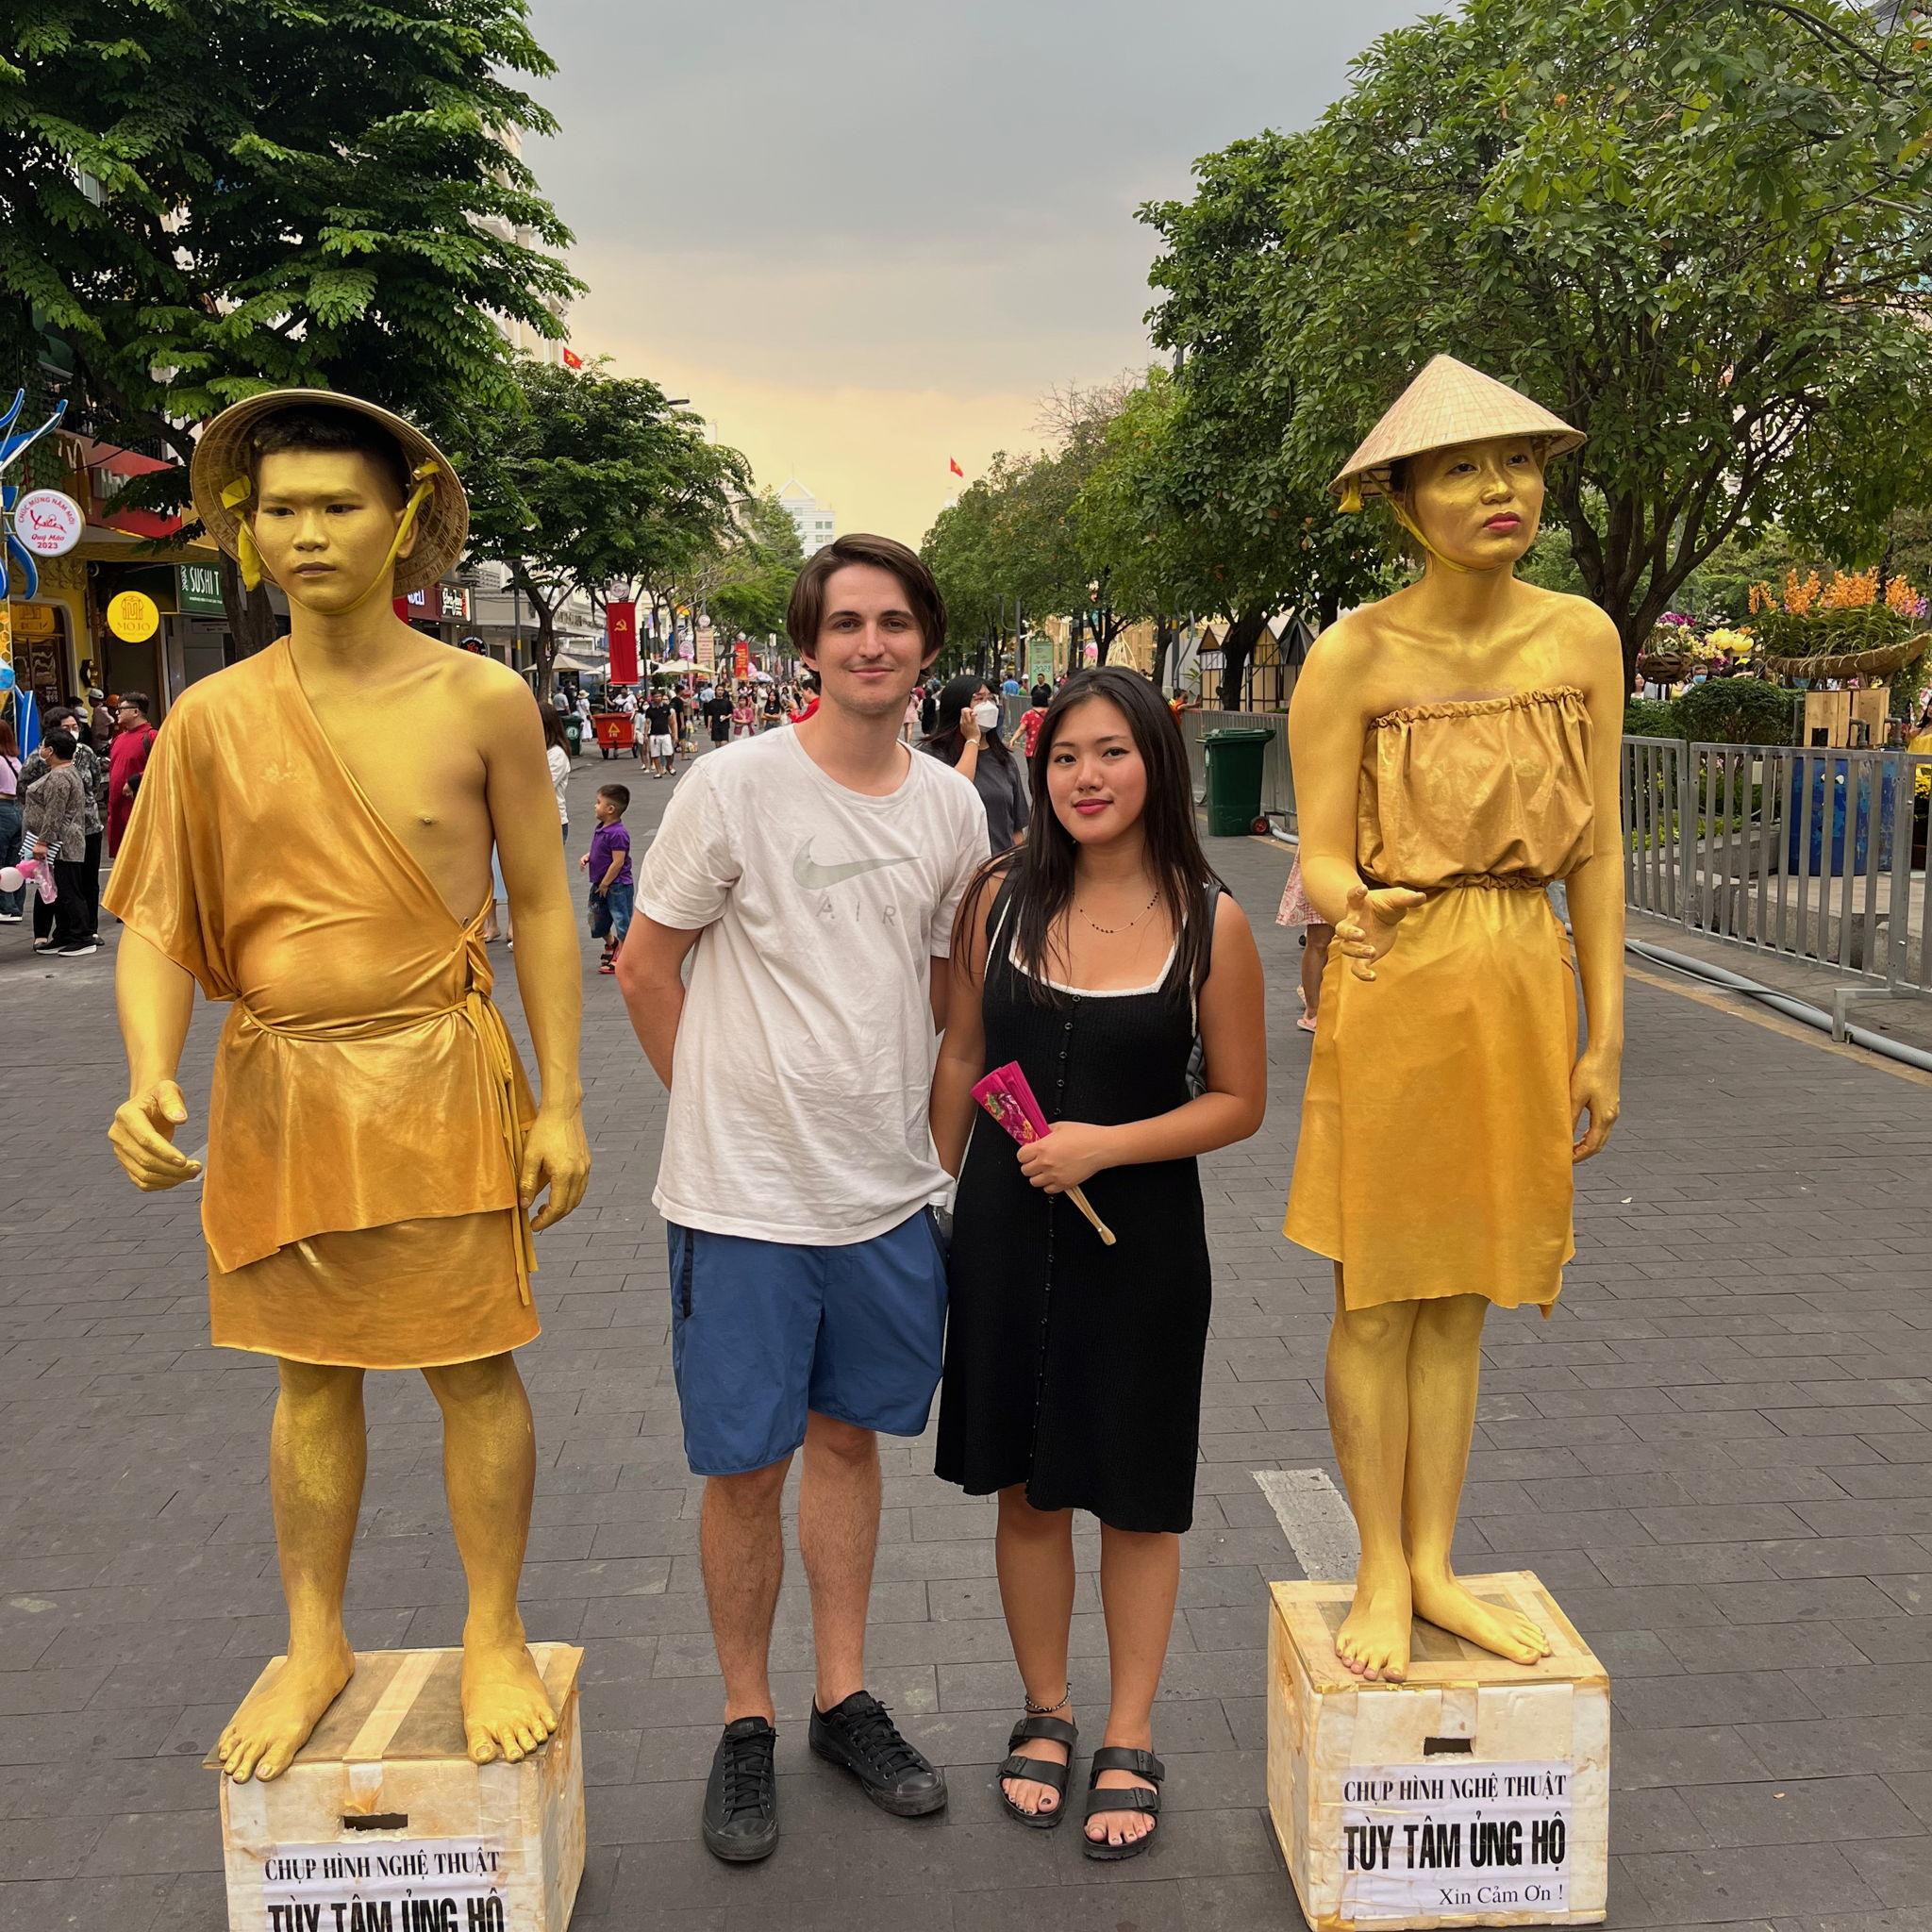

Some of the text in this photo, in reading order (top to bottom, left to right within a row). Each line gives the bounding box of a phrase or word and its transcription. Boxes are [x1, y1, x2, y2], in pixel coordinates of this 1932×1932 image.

[190, 566, 214, 595] SUSHI
[815, 892, 898, 926] AIR
[1343, 1770, 1567, 1806] CHỤP HÌNH NGHỆ THUẬT
[1343, 1809, 1566, 1872] TÙY TÂM ỦNG HỘ
[265, 1846, 500, 1885] CHỤP HÌNH NGHỆ THUẬT
[330, 1892, 393, 1932] TÂM
[1439, 1883, 1563, 1906] Xin Cảm Ơn !
